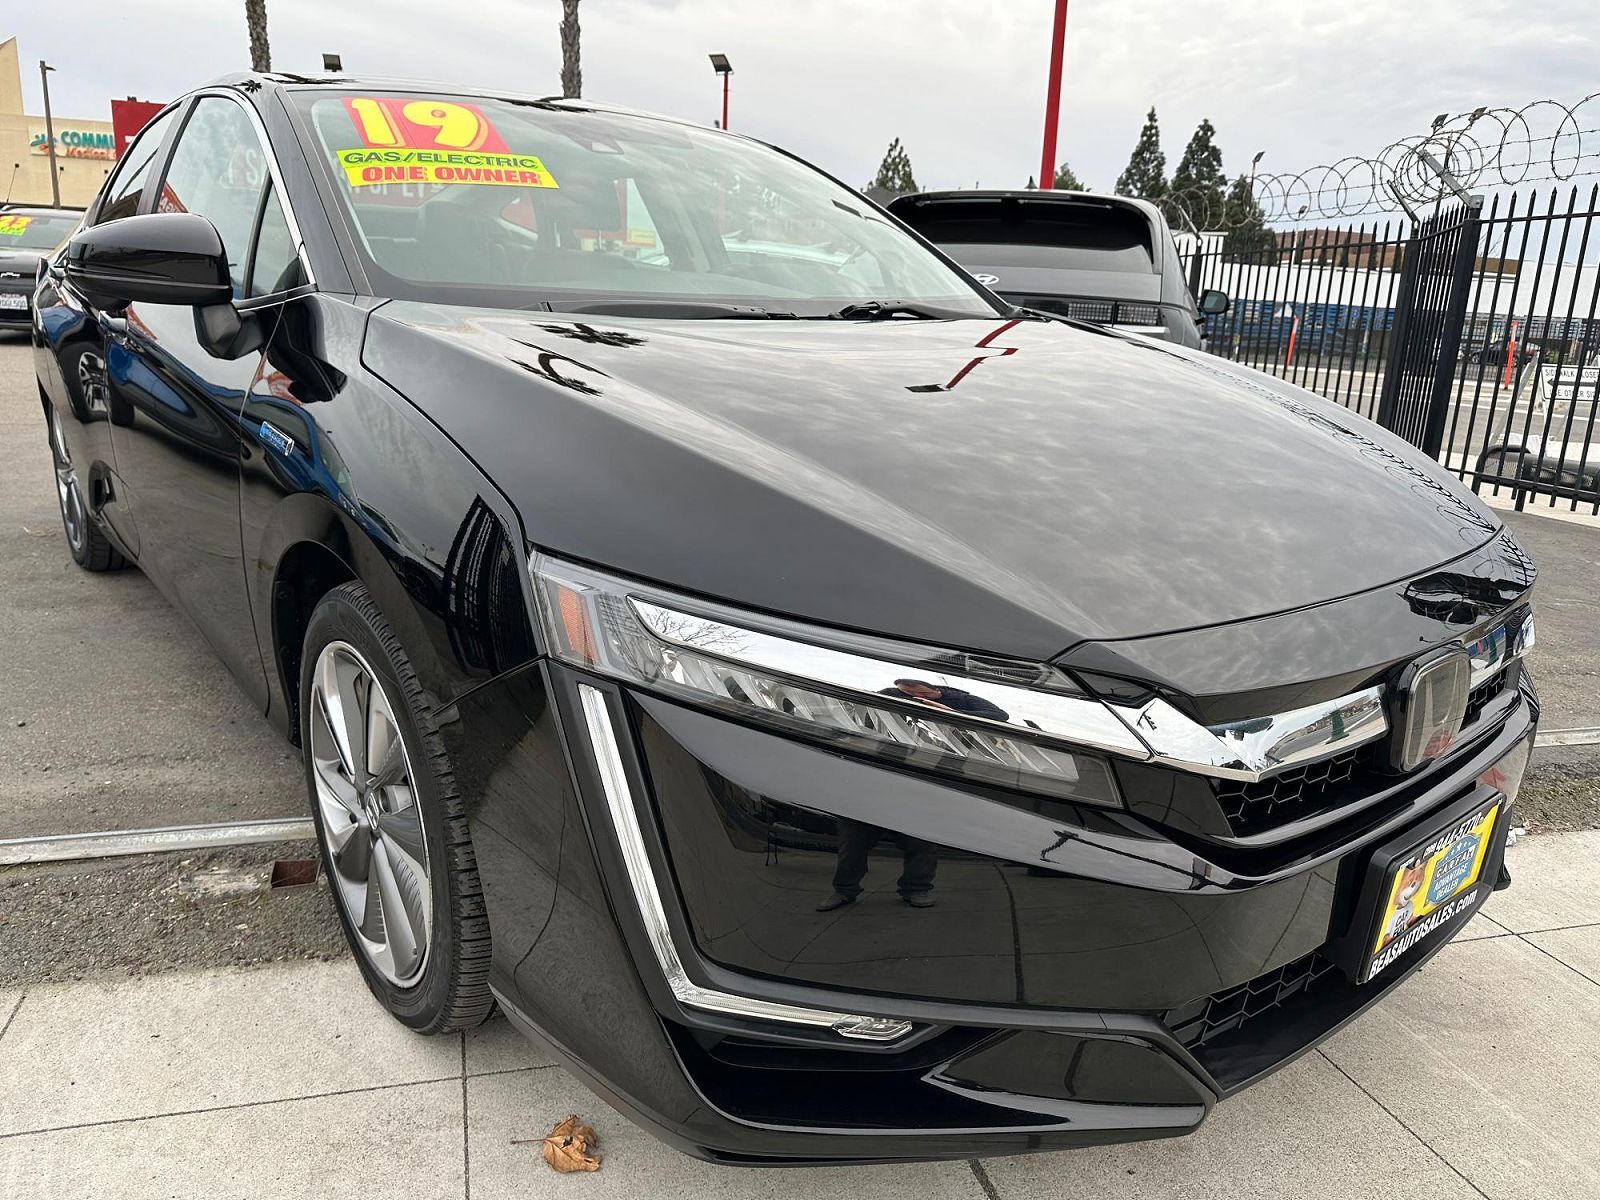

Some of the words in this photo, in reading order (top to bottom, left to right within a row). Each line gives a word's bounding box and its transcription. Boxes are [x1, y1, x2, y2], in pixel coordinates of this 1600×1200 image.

[352, 98, 489, 152] 19
[343, 152, 540, 169] GAS/ELECTRIC
[362, 166, 429, 182] ONE
[434, 167, 543, 185] OWNER
